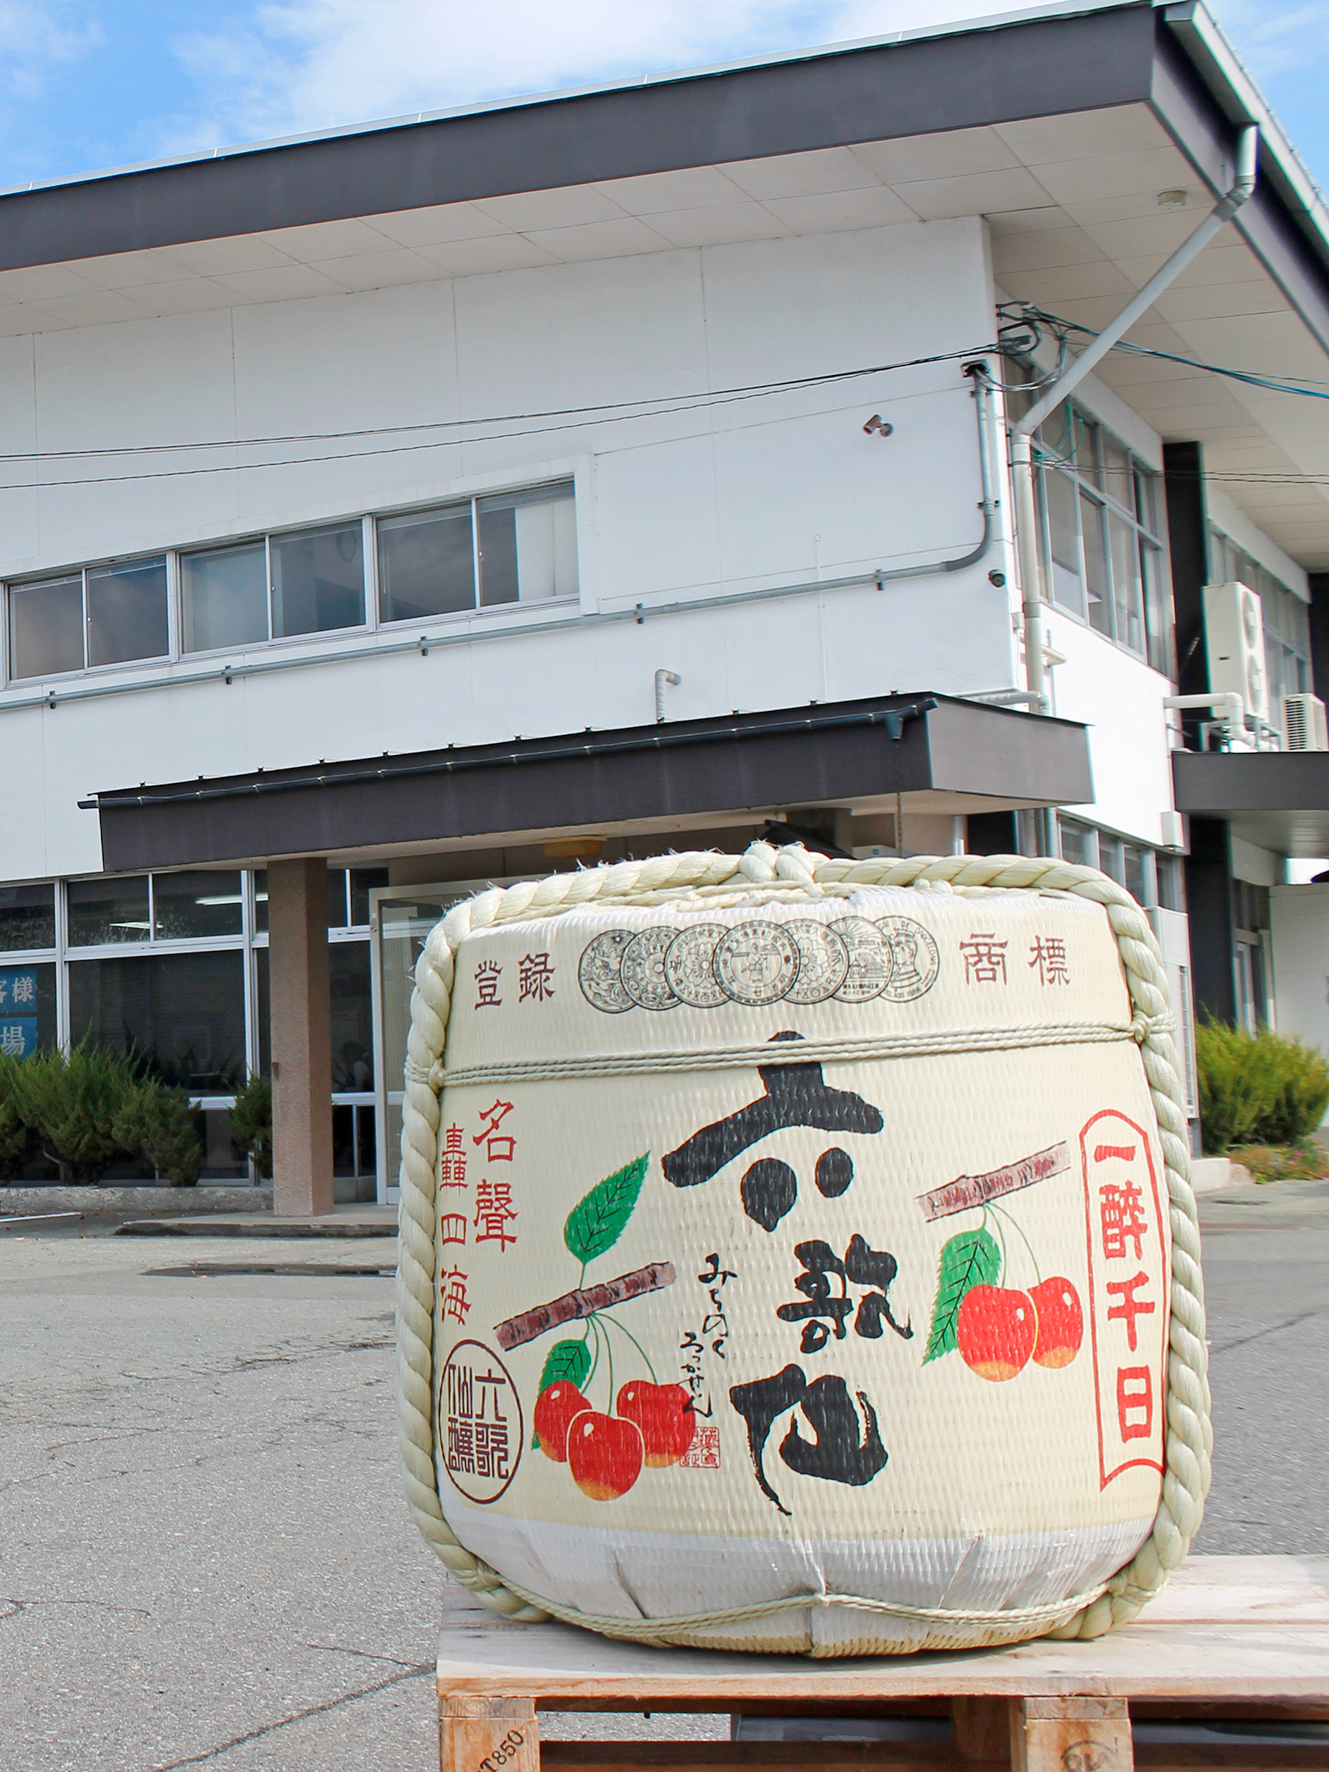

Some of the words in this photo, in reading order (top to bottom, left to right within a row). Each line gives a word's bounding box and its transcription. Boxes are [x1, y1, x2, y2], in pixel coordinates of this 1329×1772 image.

[474, 952, 557, 1011] 登録
[959, 932, 1072, 987] 商標
[698, 1253, 738, 1359] みちのく
